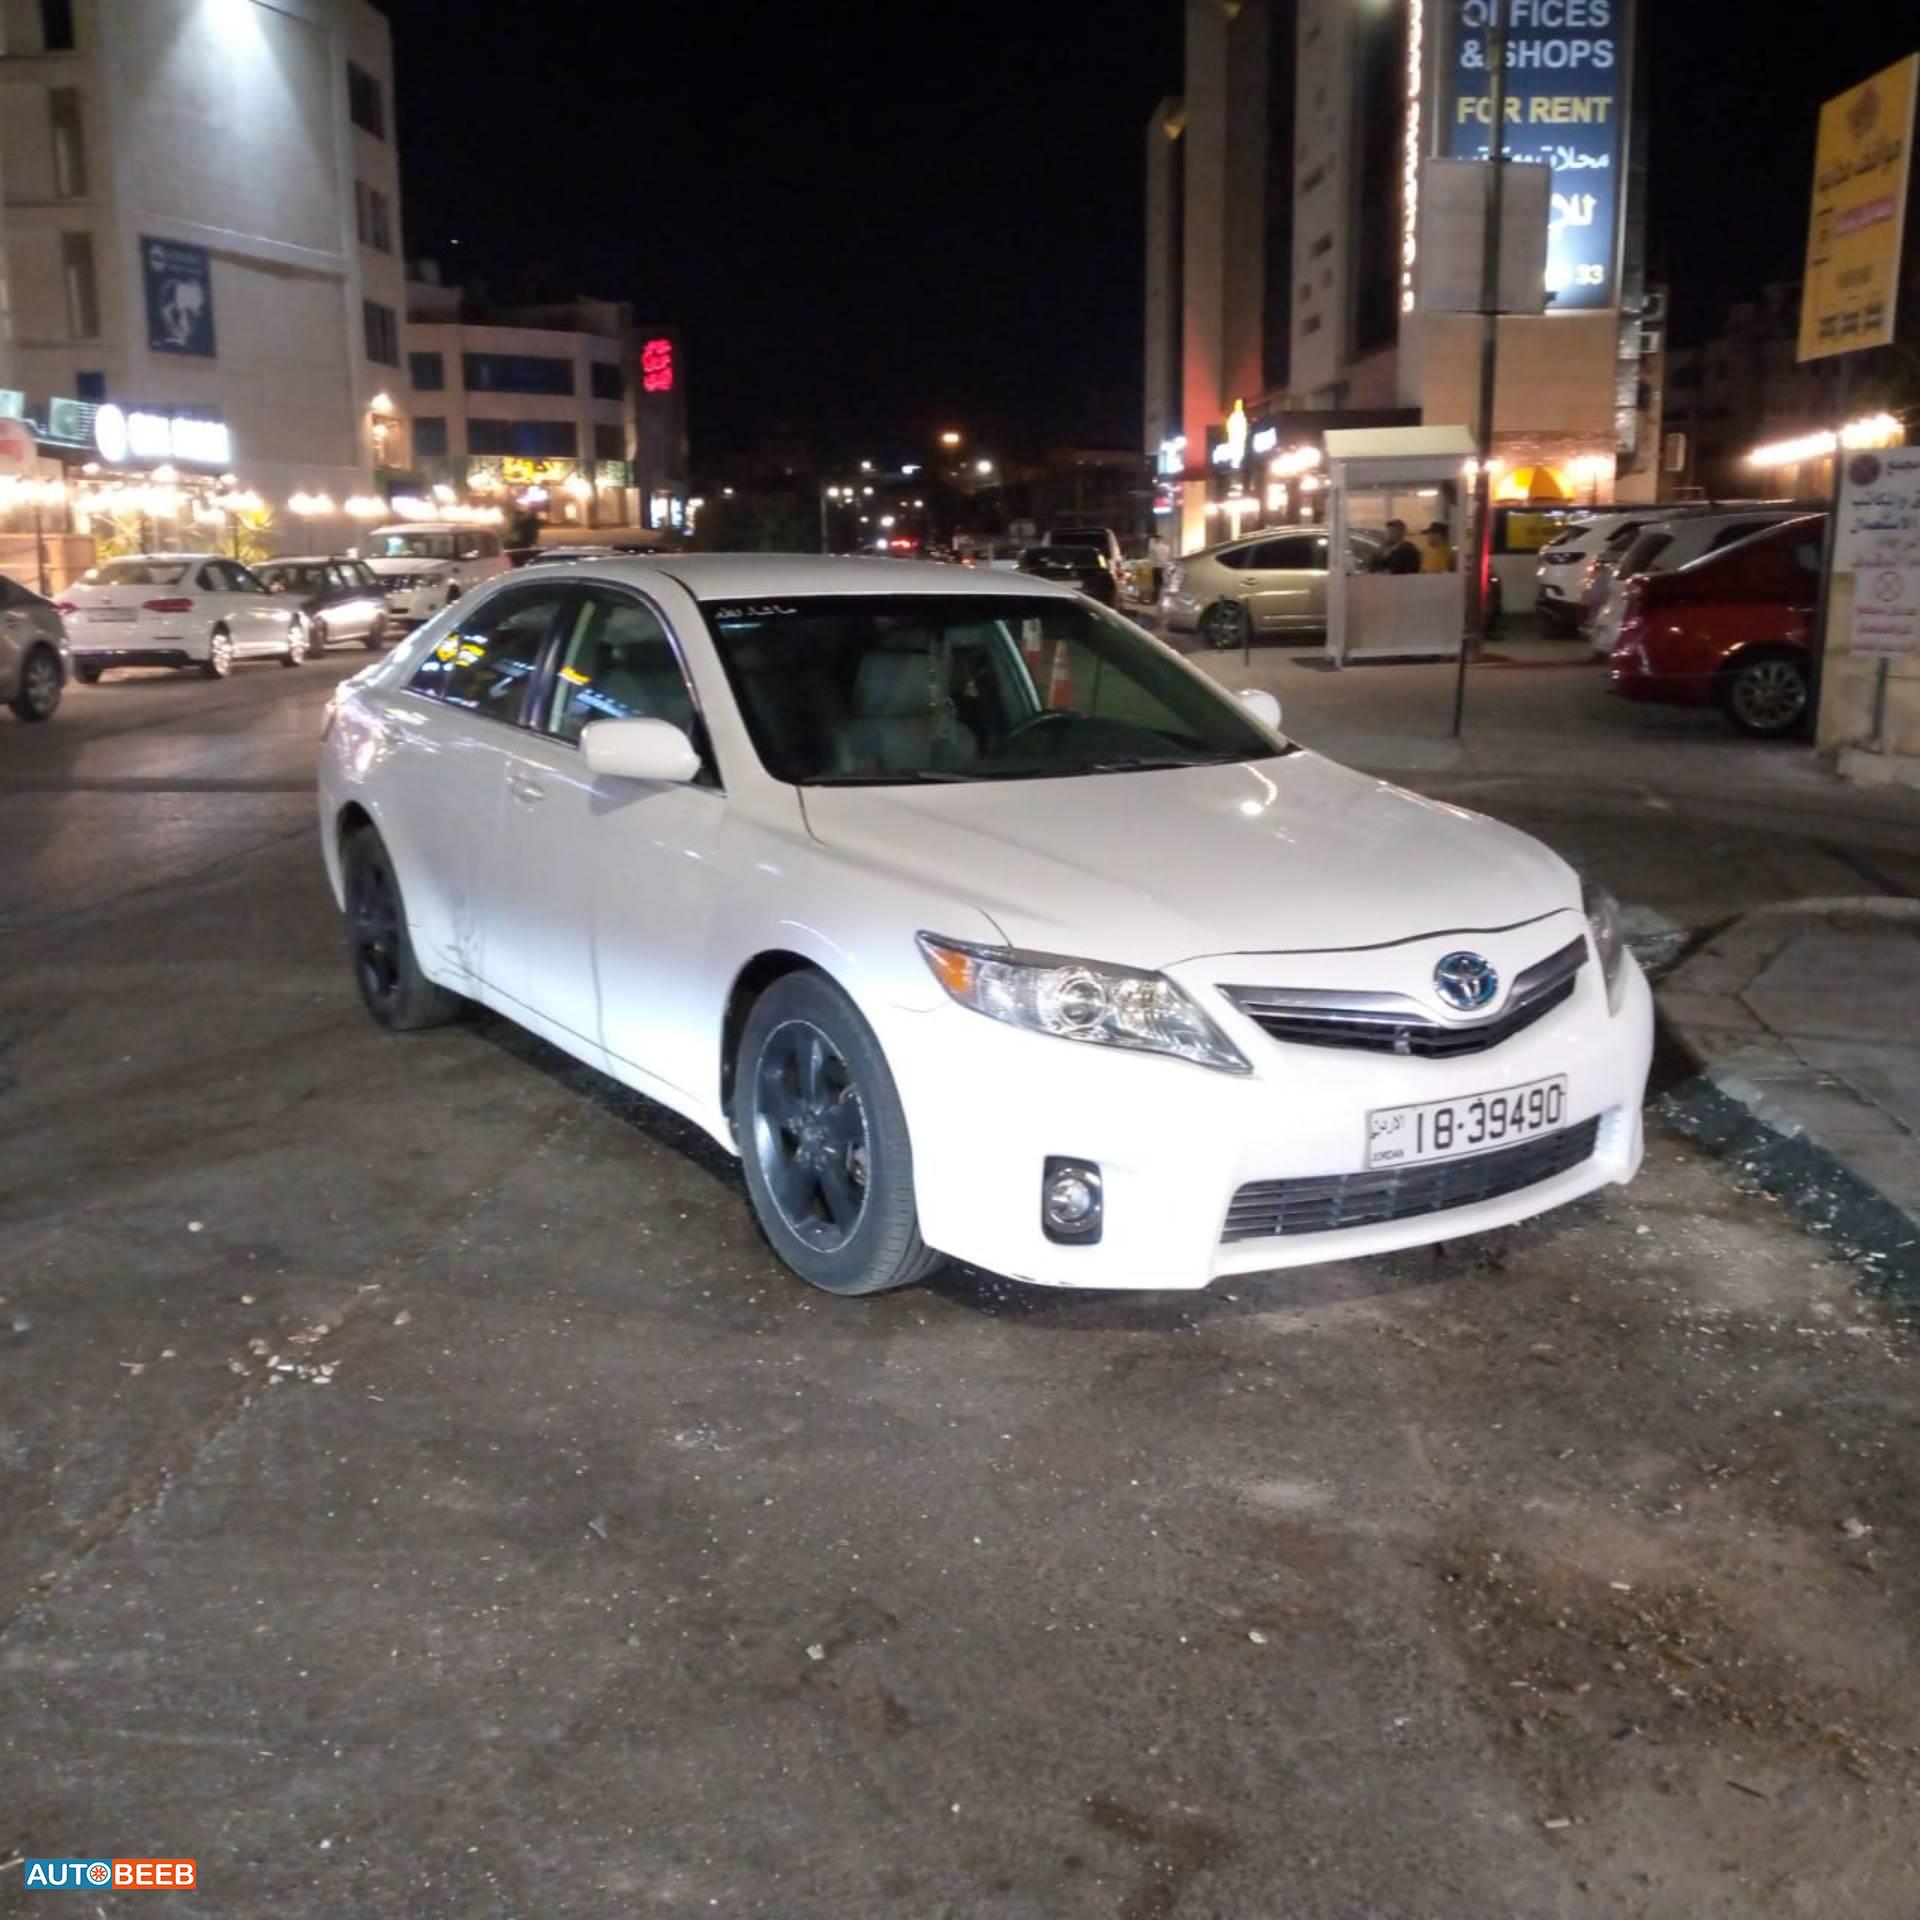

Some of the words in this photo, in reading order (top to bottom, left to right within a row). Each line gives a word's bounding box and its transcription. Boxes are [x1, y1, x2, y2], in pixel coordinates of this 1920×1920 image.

[1460, 39, 1484, 68] &
[1457, 97, 1522, 124] FOR
[1528, 97, 1612, 124] RENT
[1415, 1084, 1566, 1153] 18-39490
